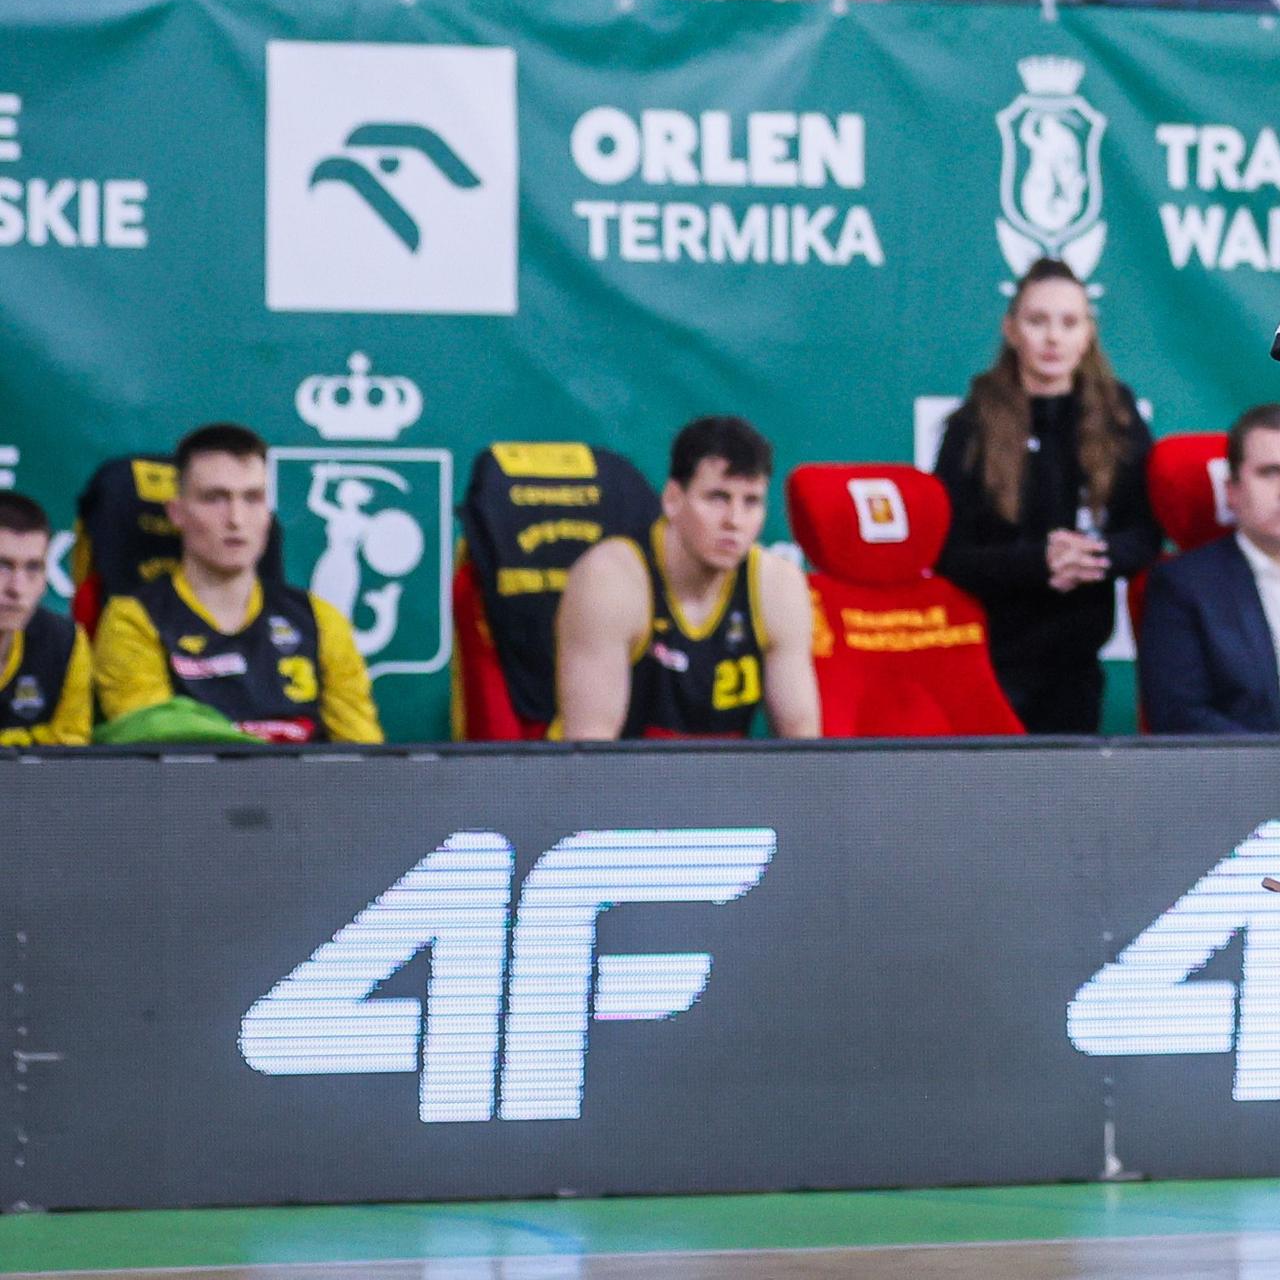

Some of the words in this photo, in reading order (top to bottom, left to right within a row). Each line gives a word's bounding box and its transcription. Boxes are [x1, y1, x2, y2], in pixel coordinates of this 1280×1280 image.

[571, 107, 867, 189] ORLEN
[572, 200, 885, 267] TERMIKA
[277, 655, 318, 703] 3
[712, 656, 763, 710] 21
[237, 828, 778, 1123] 4F
